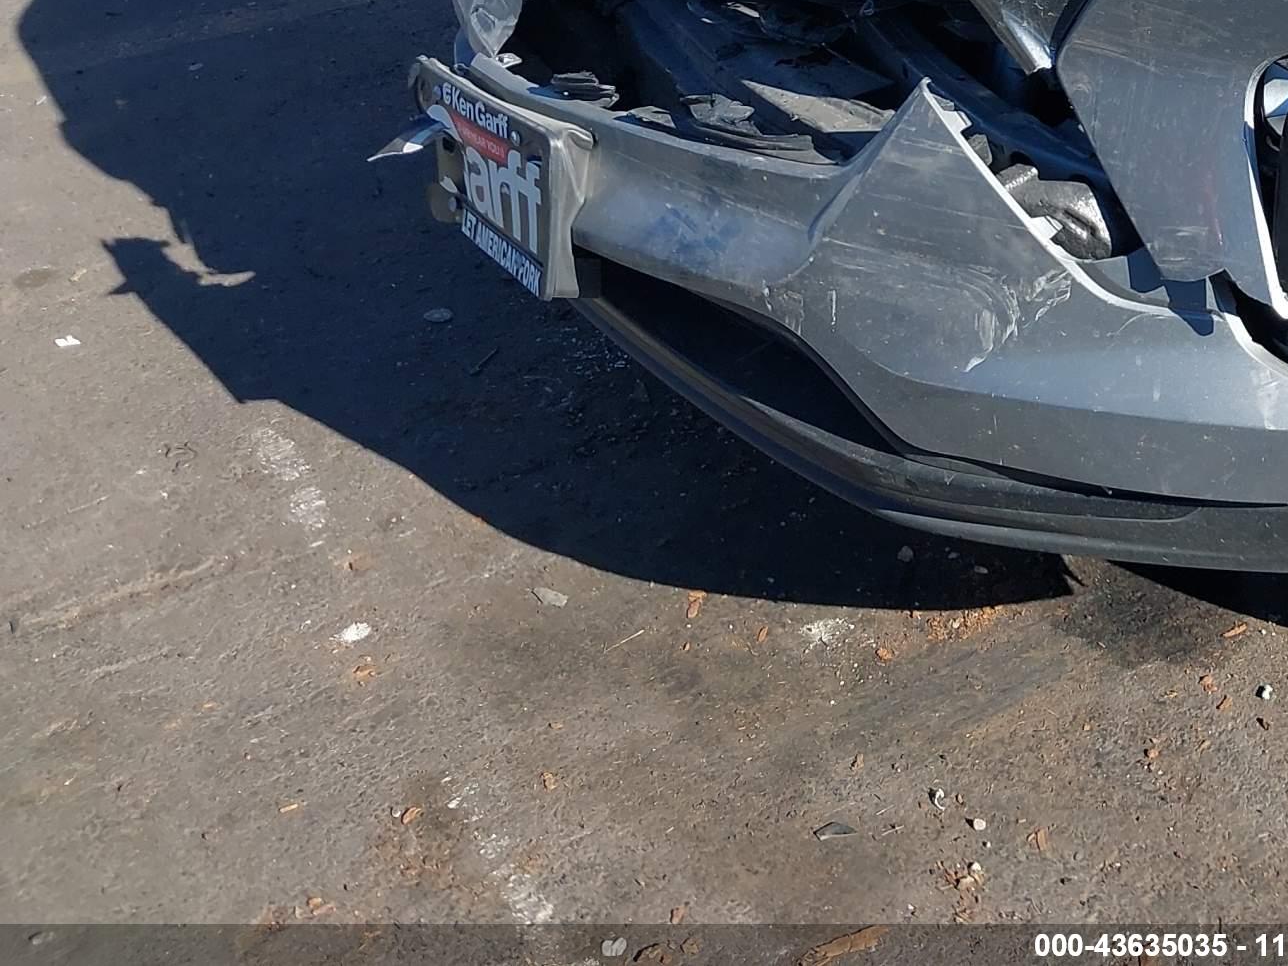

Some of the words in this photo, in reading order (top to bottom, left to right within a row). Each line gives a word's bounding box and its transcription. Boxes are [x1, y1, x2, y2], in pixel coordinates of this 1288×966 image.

[452, 86, 475, 122] Ken
[475, 100, 509, 139] Garff
[464, 146, 542, 255] arff
